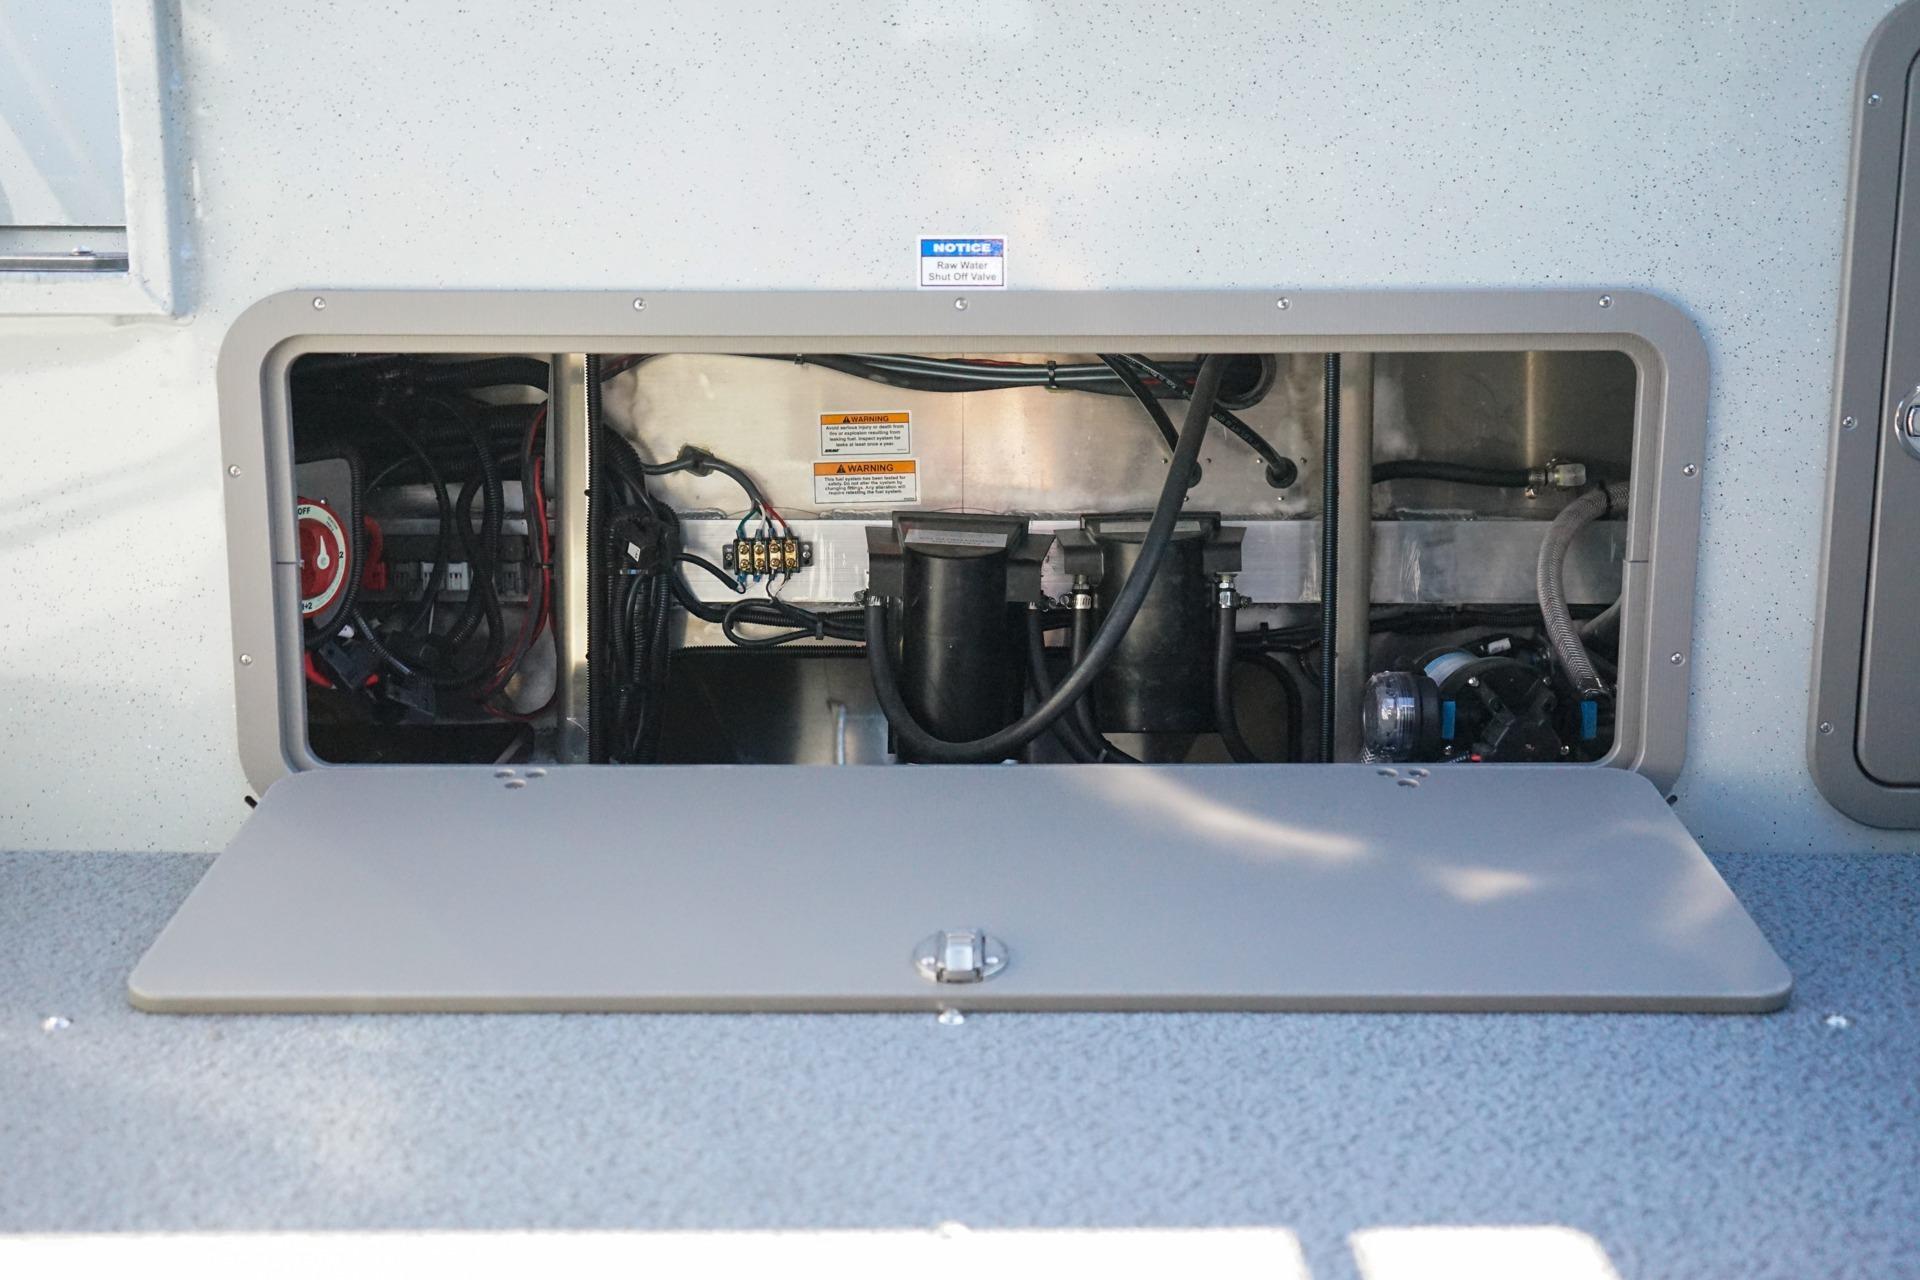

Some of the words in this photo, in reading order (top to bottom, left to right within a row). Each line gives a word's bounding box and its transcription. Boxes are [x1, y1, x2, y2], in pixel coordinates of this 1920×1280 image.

[933, 243, 991, 252] NOTICE
[848, 464, 894, 472] WARNING
[297, 507, 311, 515] OFF
